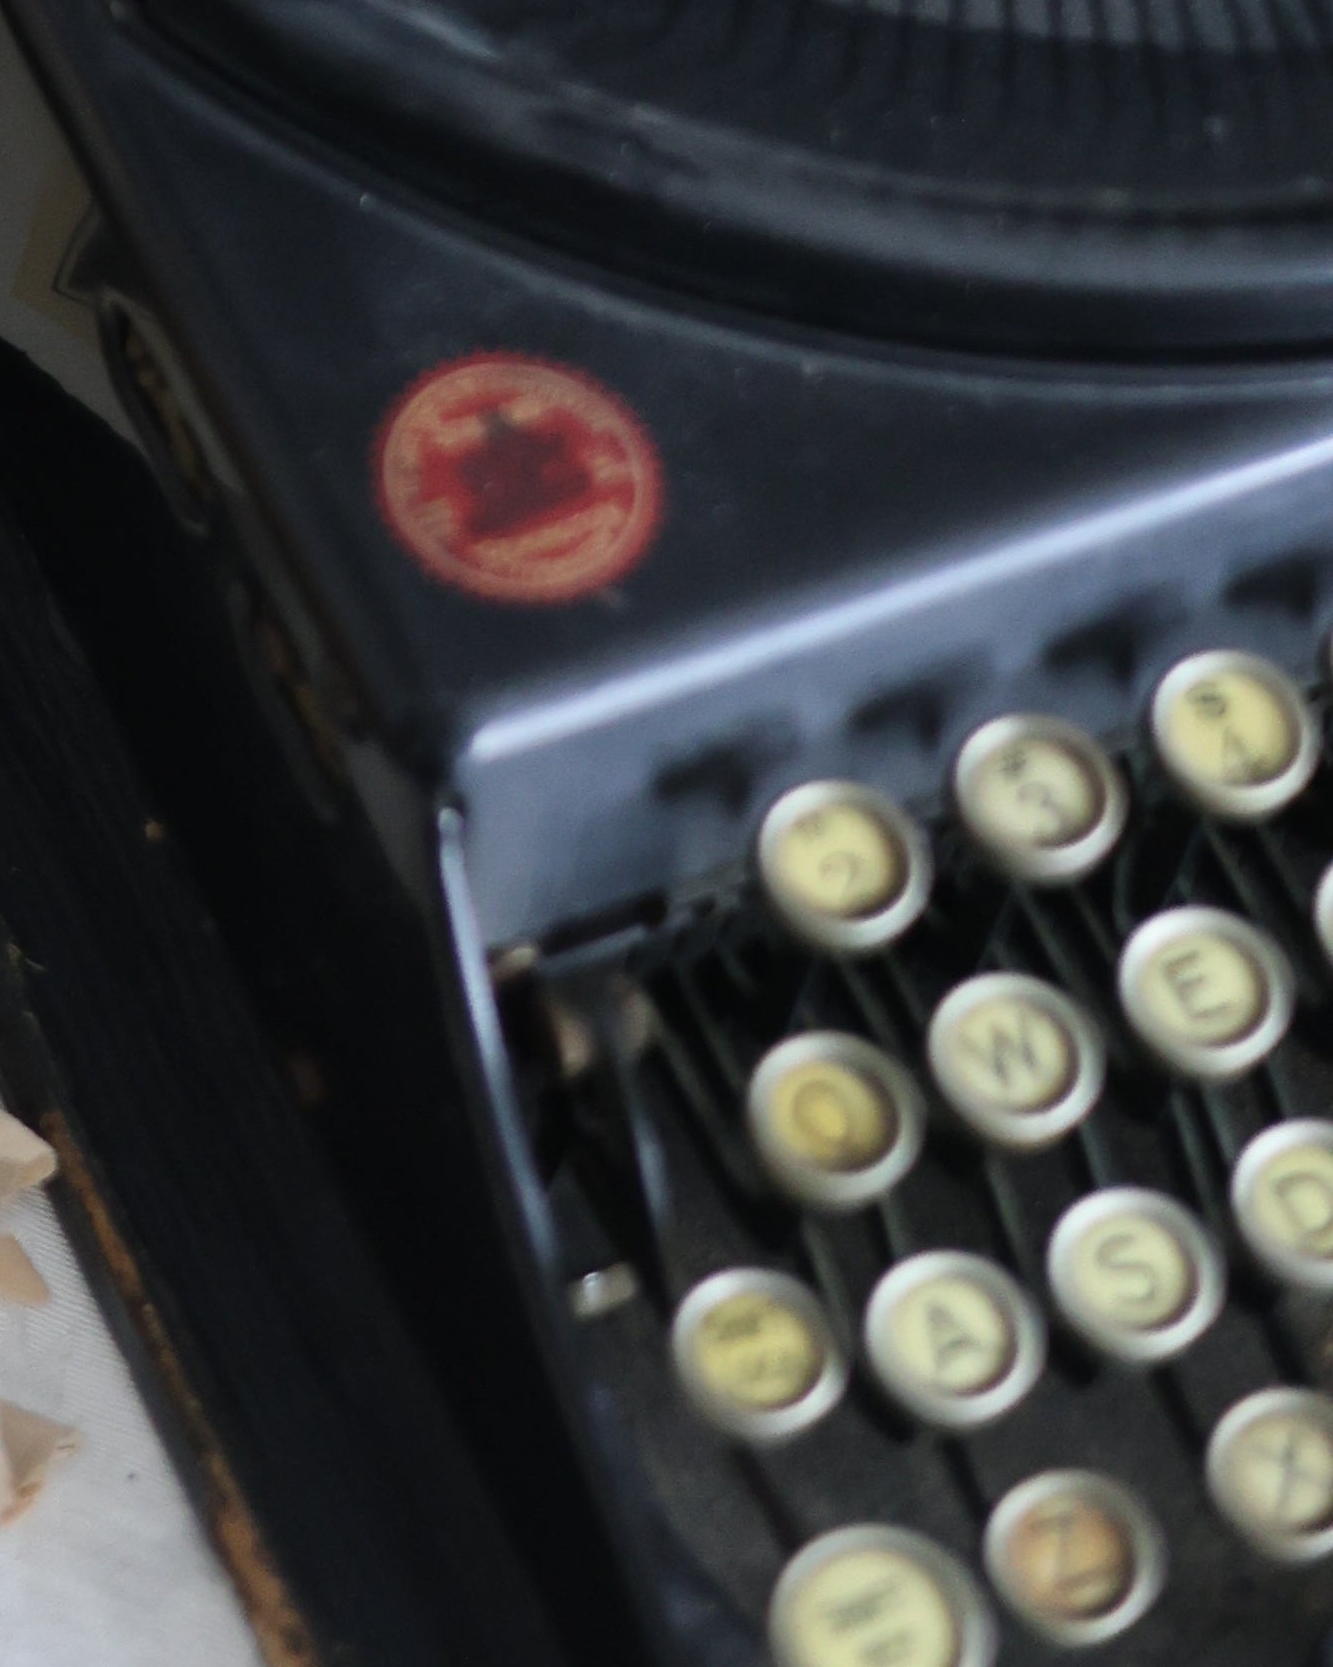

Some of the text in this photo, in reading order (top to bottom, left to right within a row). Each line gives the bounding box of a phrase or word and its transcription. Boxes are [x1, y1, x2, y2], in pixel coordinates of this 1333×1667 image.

[1162, 949, 1233, 1019] E
[959, 1001, 1037, 1085] W
[1272, 1170, 1333, 1253] D
[1095, 1233, 1160, 1307] S
[925, 1301, 982, 1361] A
